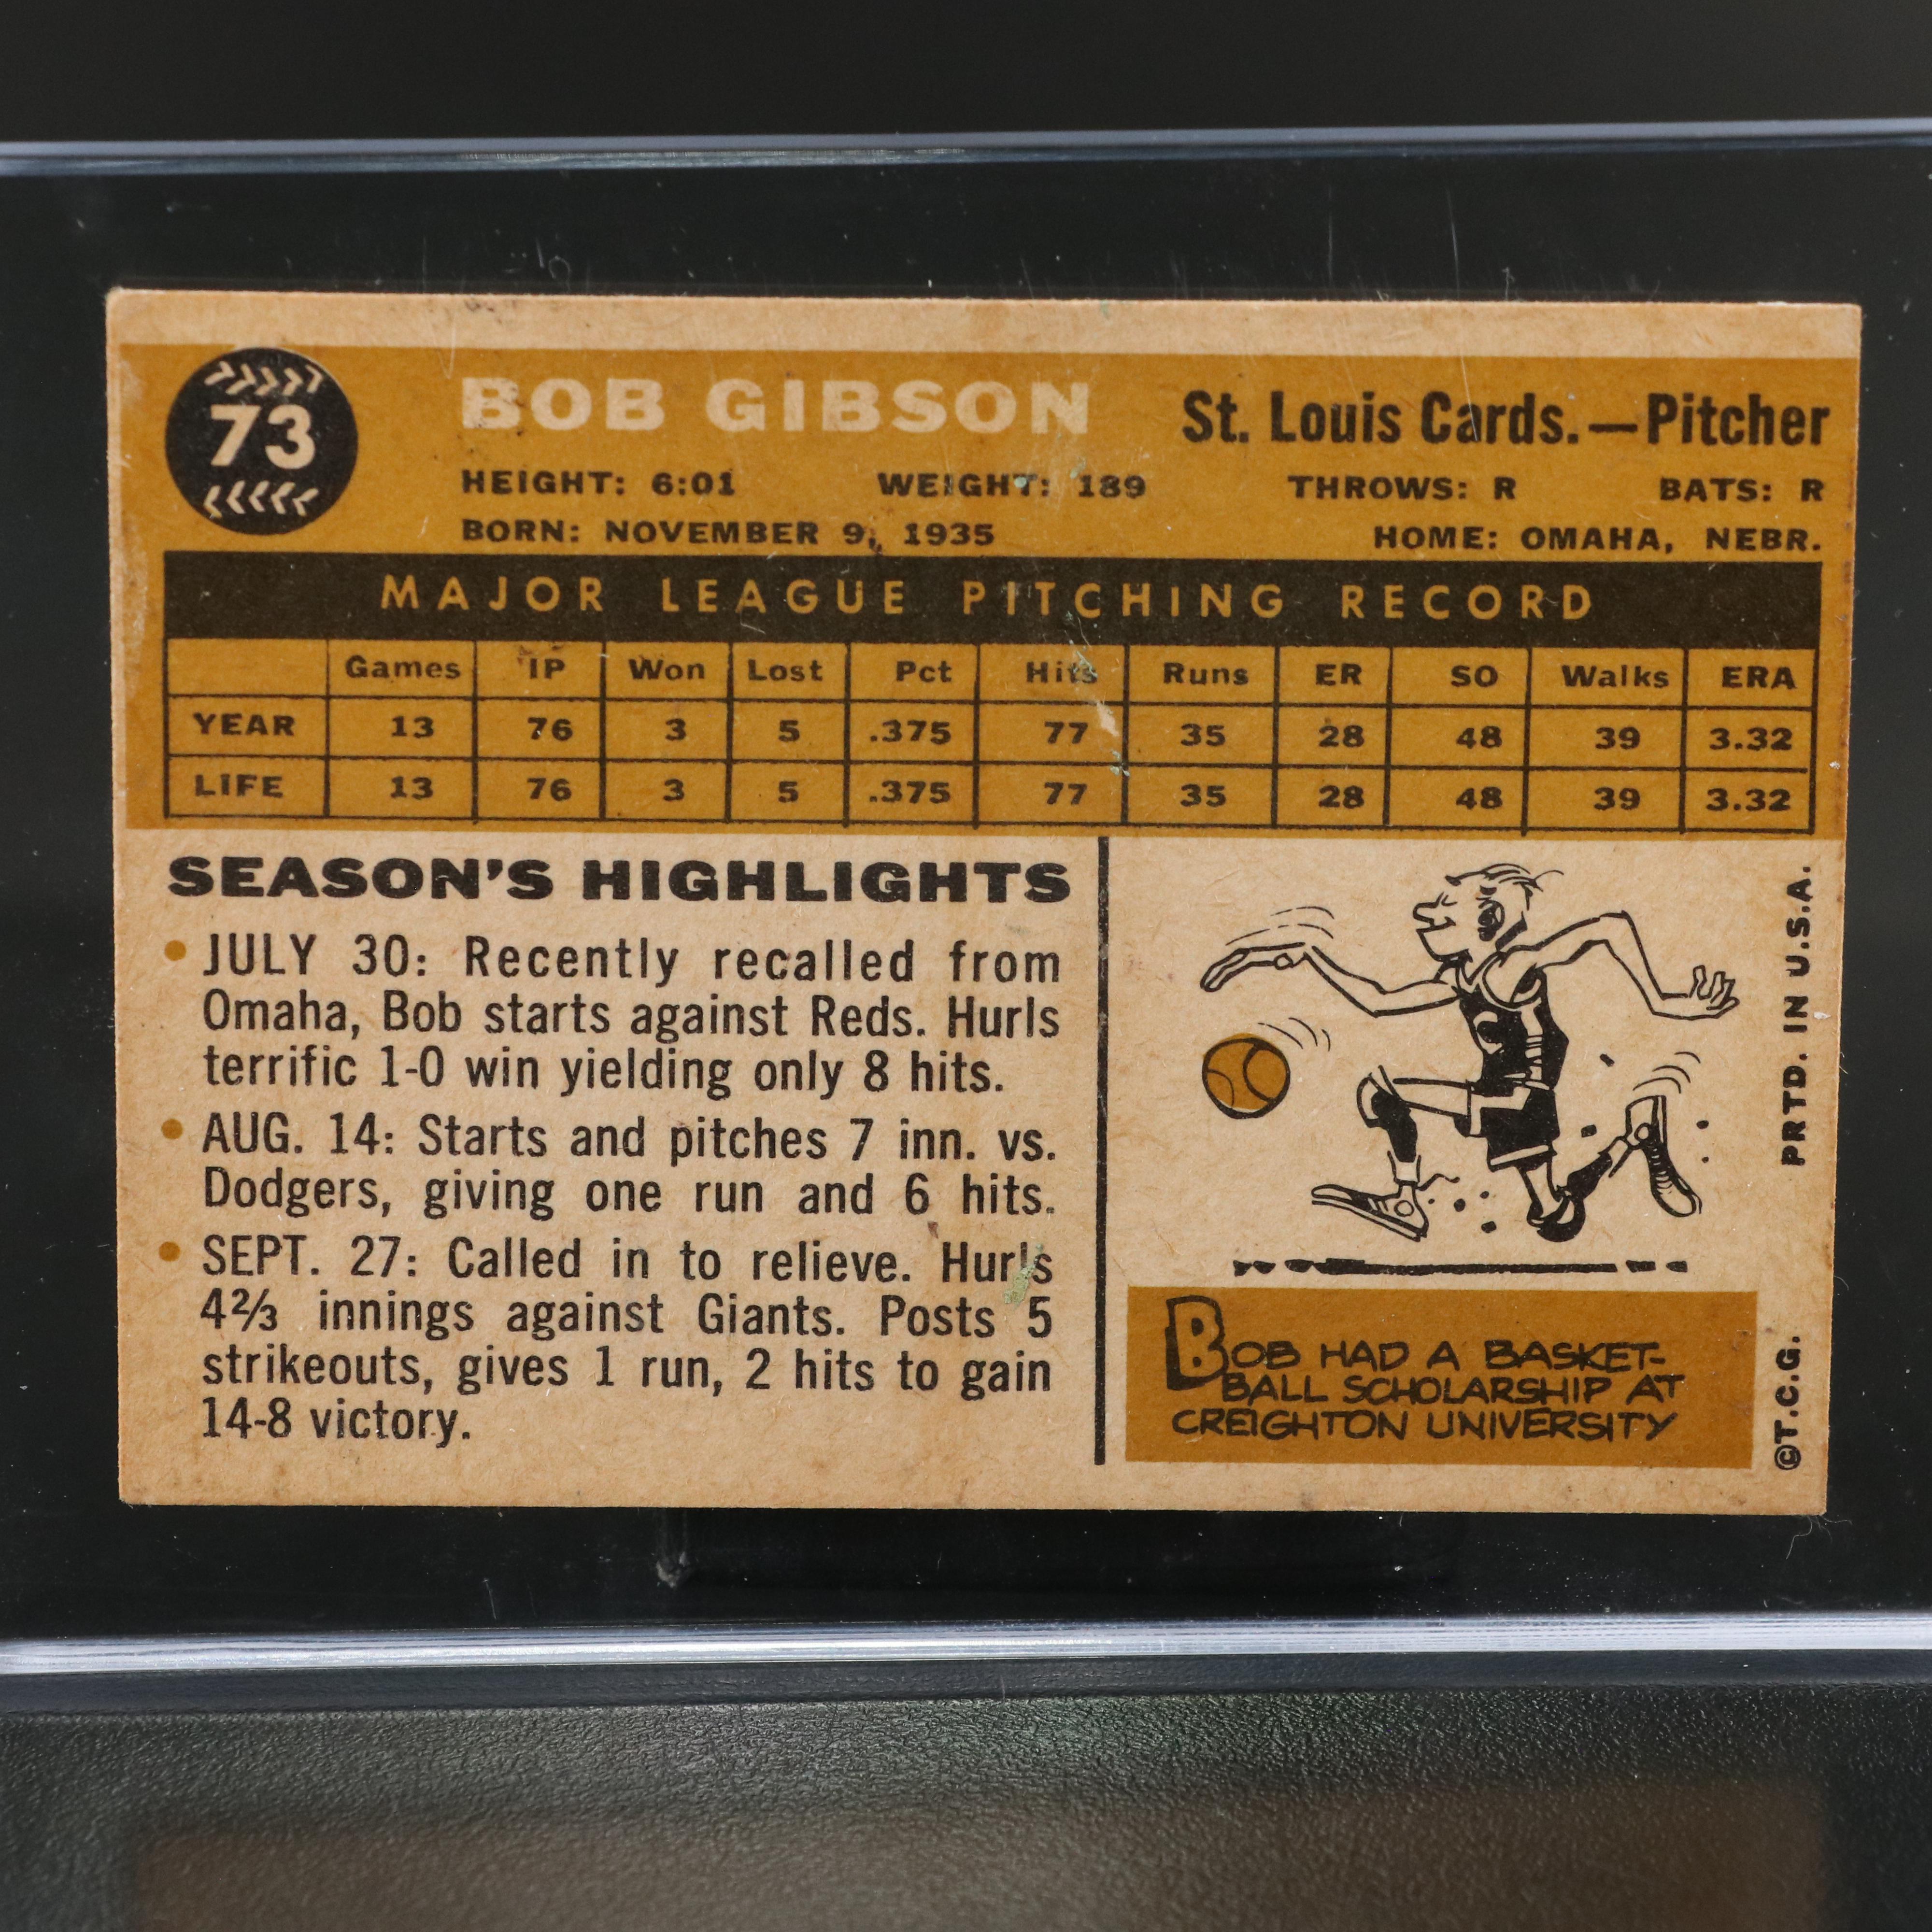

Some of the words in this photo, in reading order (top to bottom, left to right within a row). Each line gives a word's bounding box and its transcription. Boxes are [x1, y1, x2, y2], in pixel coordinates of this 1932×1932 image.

[462, 378, 664, 430] BOB
[706, 379, 1089, 434] GIBSON
[1183, 390, 1249, 443] St.
[1271, 391, 1401, 443] Louis
[211, 402, 315, 469] 73
[463, 470, 624, 495] HEIGHT:
[652, 472, 734, 495] 6:01
[878, 473, 1048, 497] WEIGHT:
[1080, 475, 1146, 498] 189
[1288, 476, 1466, 500] THROWS:
[1494, 477, 1516, 499] R
[1661, 478, 1771, 502] BATS:
[1802, 479, 1824, 501] R
[463, 519, 578, 542] BORN:
[606, 521, 818, 544] NOVEMBER
[905, 523, 994, 546] 1935
[1375, 526, 1496, 549] HOME:
[1521, 526, 1672, 554] OMAHA,
[1707, 528, 1820, 551] NEBR.
[381, 575, 602, 611] MAJOR
[662, 578, 903, 614] LEAGUE
[964, 581, 1282, 618] PITCHING
[1342, 585, 1591, 619] RECORD
[346, 655, 460, 679] Games
[530, 658, 565, 678] IP
[629, 658, 704, 680] Won
[749, 659, 822, 682] Lost
[897, 661, 951, 682] Pct
[1027, 662, 1097, 683] Hits
[1164, 663, 1248, 685] Runs
[1316, 663, 1362, 686] ER
[1451, 665, 1498, 687] SO
[1562, 665, 1668, 688] Walks
[1722, 666, 1795, 689] ERA
[194, 713, 294, 736] YEAR
[392, 716, 433, 738] 13
[528, 717, 572, 741] 76
[667, 719, 686, 740] 3
[779, 720, 799, 741] 5
[871, 720, 951, 745] .375
[1045, 722, 1088, 743] 77
[1181, 724, 1225, 746] 35
[1320, 725, 1364, 747] 28
[1457, 726, 1502, 749] 48
[1596, 727, 1640, 750] 39
[1710, 727, 1792, 751] 3.32
[196, 774, 283, 798] LIFE
[391, 777, 433, 800] 13
[528, 778, 571, 801] 76
[664, 779, 684, 801] 3
[779, 781, 798, 803] 5
[870, 781, 950, 804] .375
[1045, 782, 1087, 805] 77
[1181, 784, 1226, 807] 35
[1319, 785, 1364, 809] 28
[1456, 787, 1502, 810] 48
[1594, 787, 1640, 810] 39
[1707, 788, 1790, 811] 3.32
[169, 856, 553, 899] SEASON'S
[583, 860, 1070, 903] HIGHLIGHTS
[1786, 867, 1812, 977] U.S.A.
[204, 933, 315, 975] JULY
[353, 934, 425, 977] 30:
[467, 936, 678, 987] Recently
[715, 939, 913, 982] recalled
[950, 940, 1059, 982] from
[204, 989, 359, 1039] Omaha,
[384, 990, 461, 1032] Bob
[485, 994, 610, 1034] starts
[631, 994, 788, 1043] against
[812, 995, 924, 1037] Reds.
[949, 996, 1059, 1038] Hurls
[1783, 996, 1808, 1032] IN
[204, 1045, 356, 1086] terrific
[382, 1046, 443, 1087] 1-0
[466, 1047, 538, 1089] win
[561, 1048, 732, 1101] yielding
[755, 1050, 843, 1100] only
[864, 1050, 888, 1092] 8
[911, 1051, 1002, 1093] hits.
[1781, 1054, 1807, 1165] PRTD.
[203, 1112, 302, 1153] AUG.
[330, 1112, 392, 1155] 14:
[419, 1114, 546, 1157] Starts
[571, 1116, 644, 1157] and
[671, 1117, 826, 1166] pitches
[851, 1118, 873, 1161] 7
[900, 1118, 975, 1159] inn.
[998, 1130, 1055, 1161] vs.
[205, 1166, 390, 1218] Dodgers,
[424, 1169, 554, 1221] giving
[586, 1180, 661, 1212] one
[696, 1182, 762, 1212] run
[799, 1173, 873, 1214] and
[906, 1173, 929, 1215] 6
[963, 1173, 1054, 1215] hits.
[203, 1235, 318, 1276] SEPT.
[351, 1235, 415, 1277] 27:
[449, 1237, 580, 1278] Called
[613, 1237, 648, 1279] in
[680, 1241, 721, 1280] to
[753, 1240, 910, 1282] relieve.
[943, 1242, 1052, 1284] Hurls
[320, 1290, 473, 1340] innings
[507, 1292, 663, 1341] against
[698, 1293, 844, 1336] Giants.
[881, 1295, 994, 1338] Posts
[1028, 1296, 1051, 1338] 5
[1165, 1295, 1302, 1391] BOB
[1321, 1340, 1409, 1372] HAD
[1426, 1341, 1460, 1371] A
[1484, 1339, 1666, 1374] BASKET-
[203, 1344, 432, 1394] strikeouts,
[457, 1345, 568, 1395] gives
[597, 1346, 613, 1386] 1
[642, 1357, 722, 1396] run,
[746, 1348, 770, 1389] 2
[796, 1349, 874, 1391] hits
[897, 1351, 938, 1391] to
[961, 1350, 1050, 1401] gain
[1221, 1374, 1329, 1405] BALL
[1343, 1375, 1612, 1406] SCHOLARSHIP
[1626, 1374, 1685, 1405] AT
[203, 1397, 291, 1439] 14-8
[310, 1398, 469, 1448] victory.
[1172, 1408, 1408, 1440] CREIGHTON
[1427, 1406, 1678, 1442] UNIVERSITY
